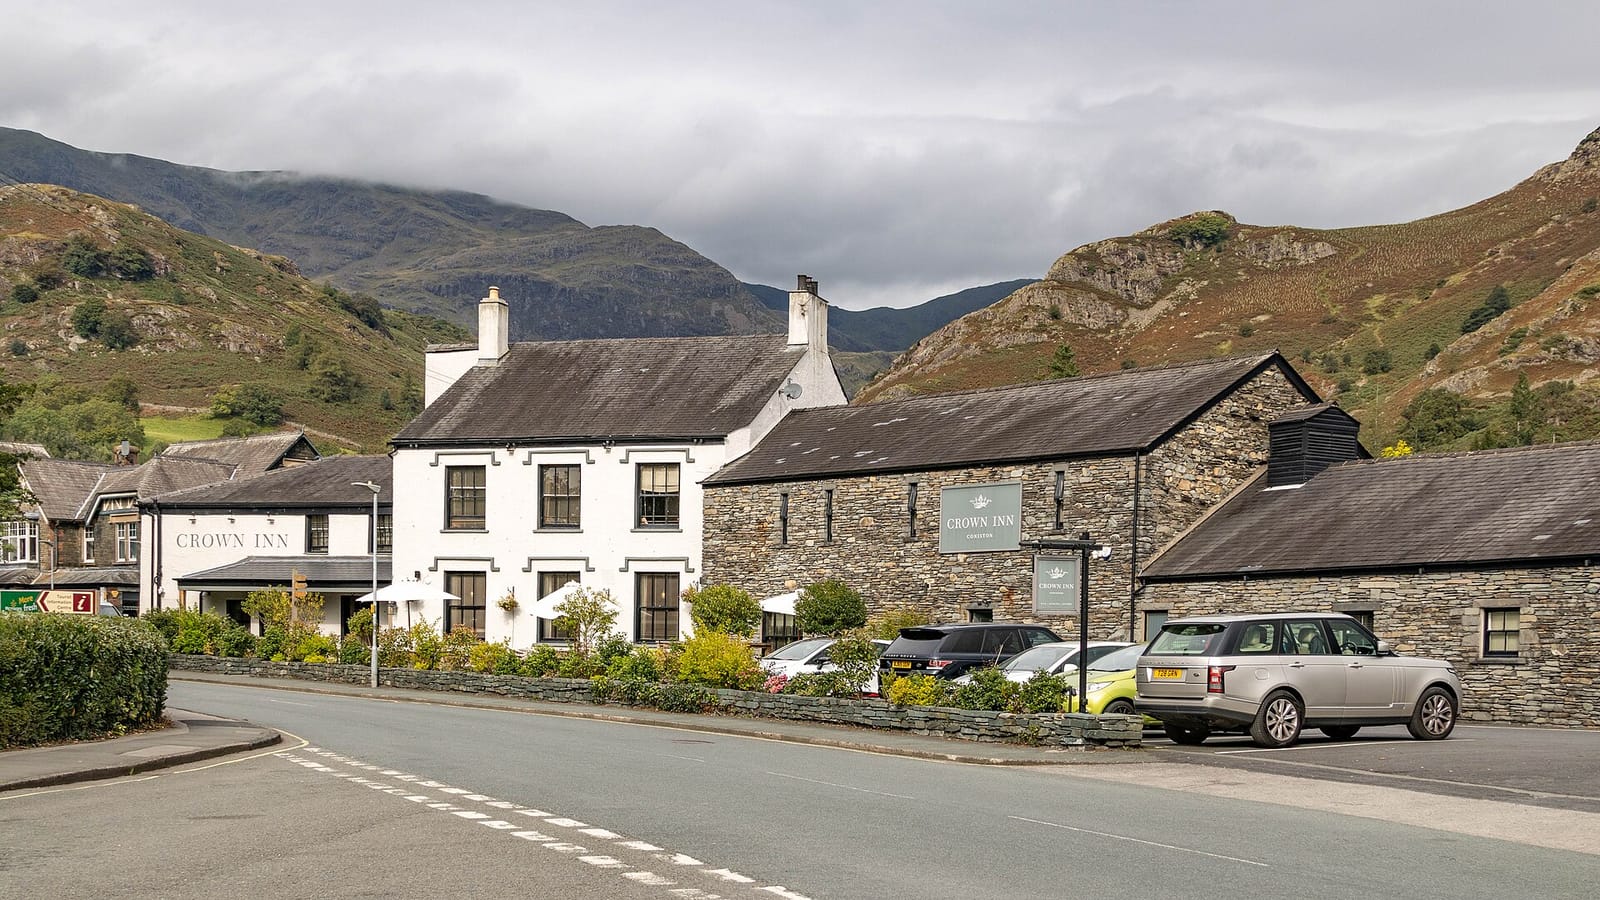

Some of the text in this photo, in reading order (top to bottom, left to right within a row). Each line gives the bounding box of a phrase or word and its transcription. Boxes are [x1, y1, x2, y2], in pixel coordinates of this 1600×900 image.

[947, 514, 1014, 529] CROWN INN
[176, 533, 288, 548] CROWN INN
[18, 596, 34, 604] More
[23, 602, 38, 611] fresh
